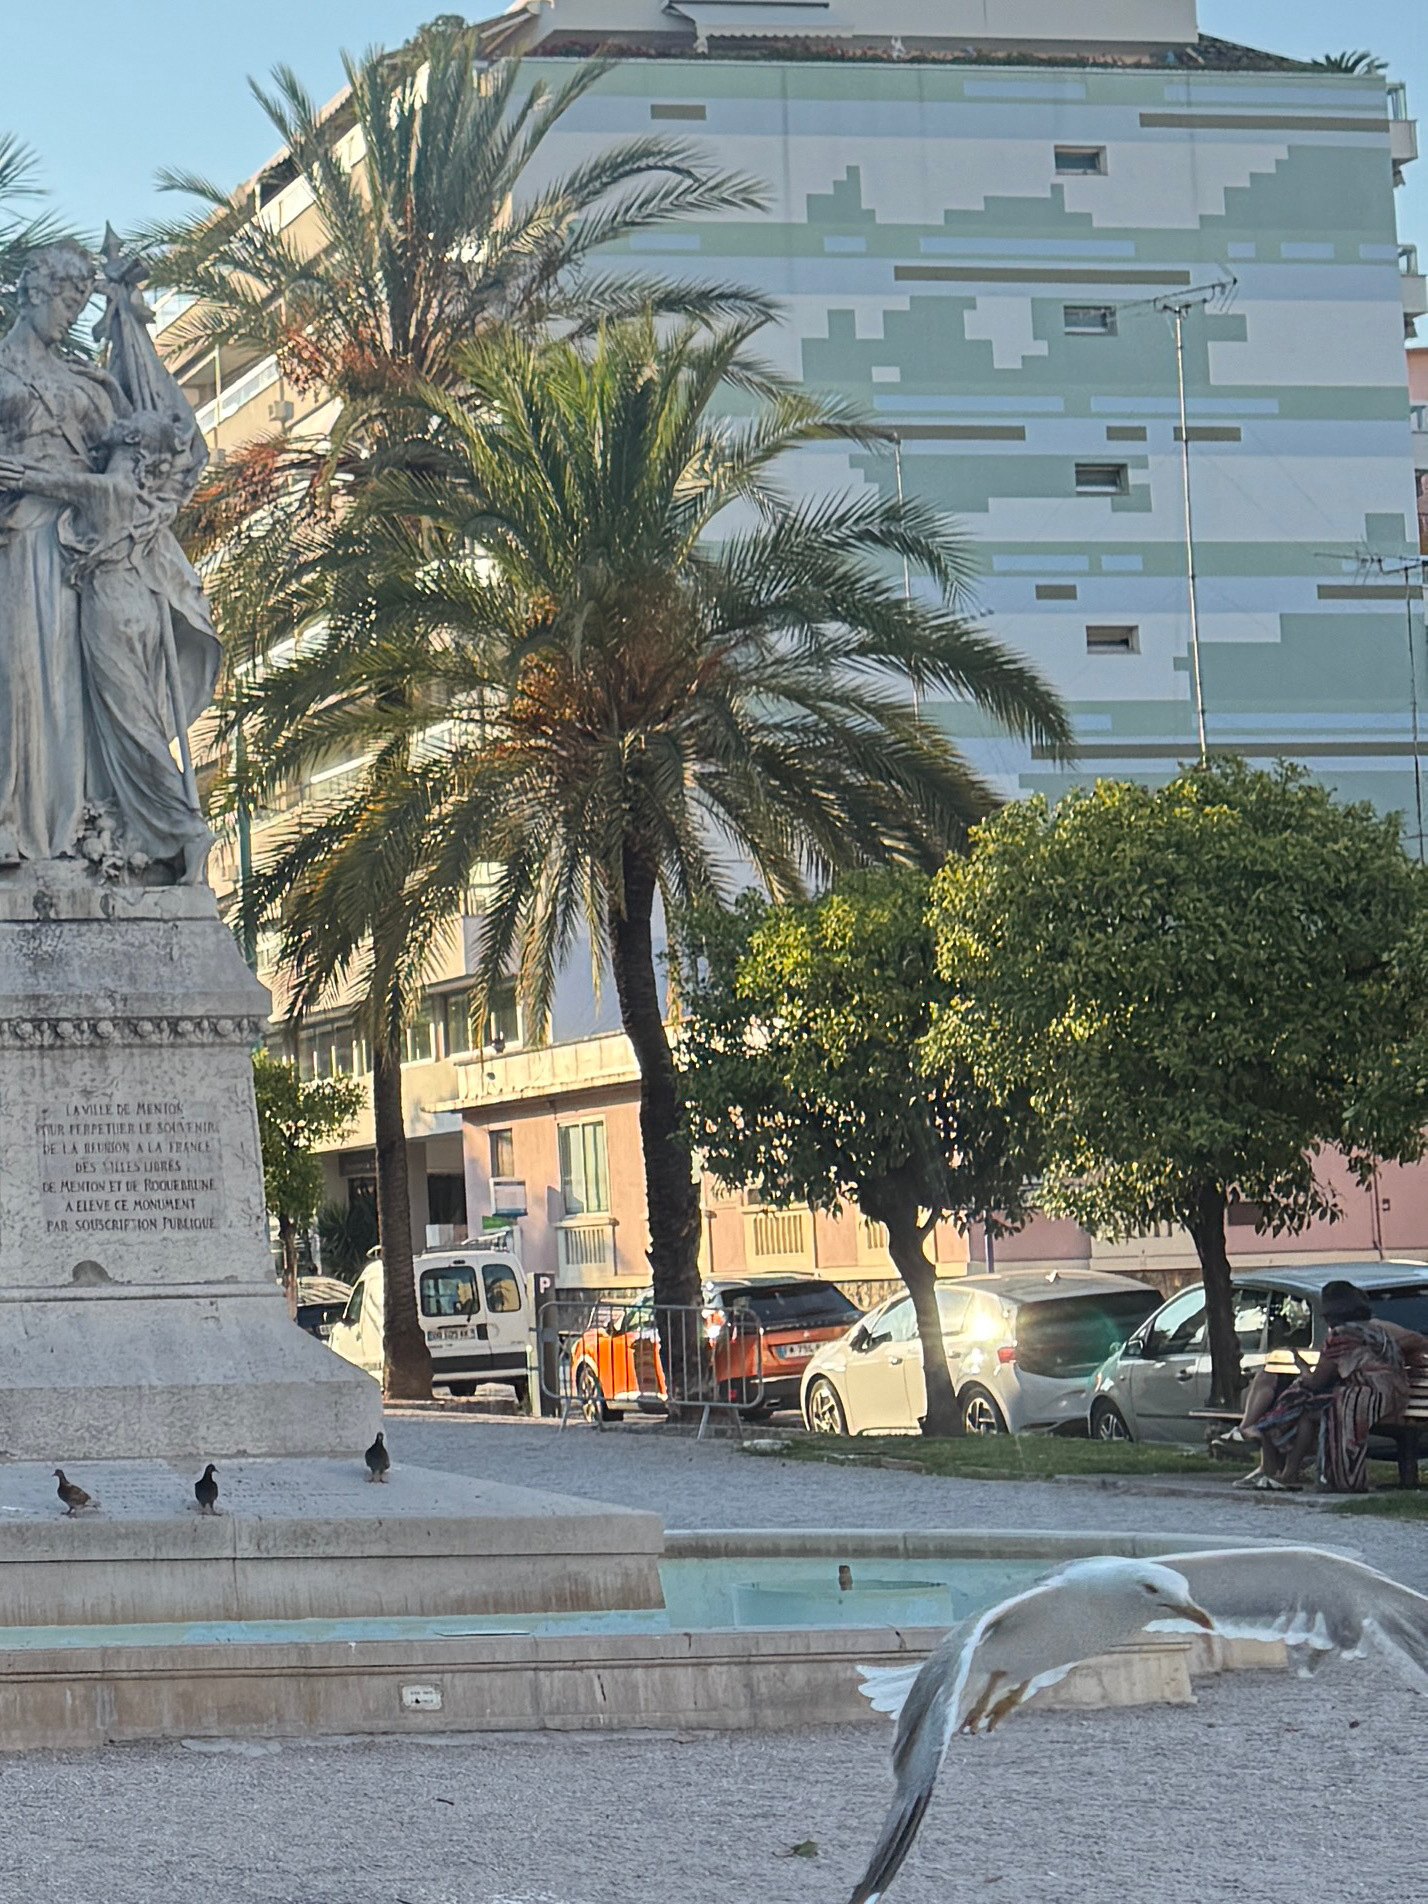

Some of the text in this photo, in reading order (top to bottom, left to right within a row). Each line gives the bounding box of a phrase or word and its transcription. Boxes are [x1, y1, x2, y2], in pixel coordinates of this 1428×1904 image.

[82, 1102, 113, 1117] VILLE
[116, 1102, 130, 1116] DE
[139, 1121, 152, 1135] LE
[63, 1142, 79, 1155] LA
[148, 1141, 162, 1154] LA
[75, 1161, 97, 1174] DES
[43, 1181, 56, 1194] DE
[60, 1180, 106, 1194] MENTON
[109, 1179, 123, 1194] ET
[114, 1198, 129, 1212] CE
[133, 1197, 197, 1212] MONUMENT
[46, 1218, 69, 1233] PAR
[539, 1276, 551, 1294] P
